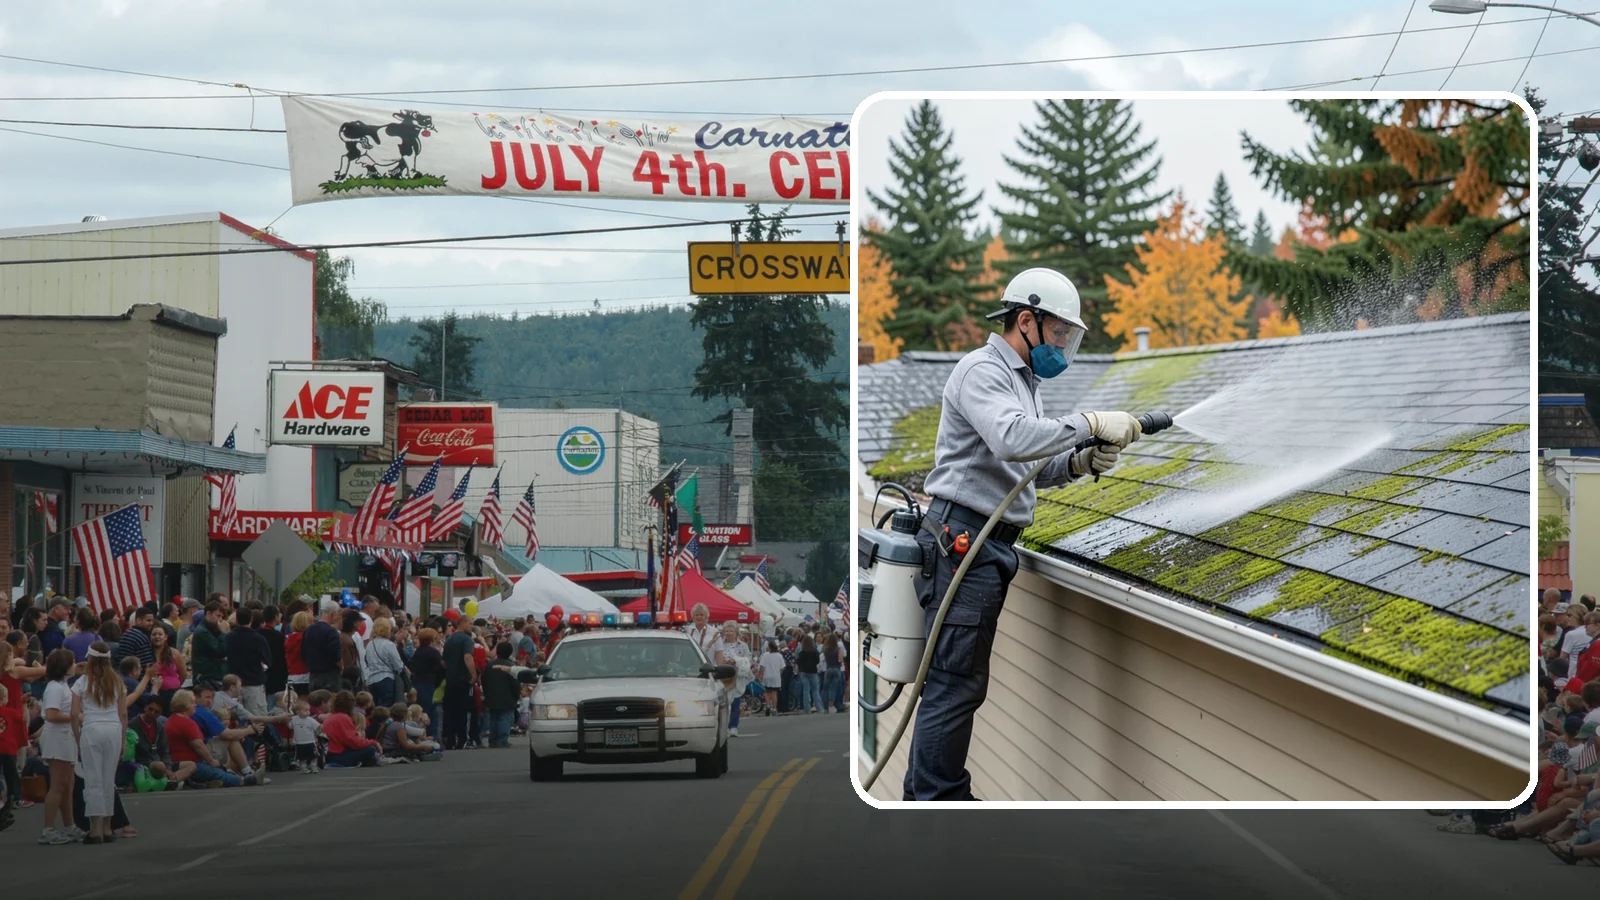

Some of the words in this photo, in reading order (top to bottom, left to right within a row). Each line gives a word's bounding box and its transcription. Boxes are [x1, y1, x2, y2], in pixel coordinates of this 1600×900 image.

[694, 121, 850, 150] Carnat
[481, 141, 605, 193] JULY
[632, 150, 747, 198] 4th.
[696, 254, 850, 280] CROSSWA
[282, 379, 374, 420] ACE
[405, 409, 452, 422] CEDAR
[461, 409, 485, 422] LOG
[283, 421, 371, 437] Hardware
[416, 427, 477, 447] Coca-Cola
[83, 485, 93, 494] St.
[96, 485, 125, 495] Vincent
[126, 486, 135, 495] de
[137, 486, 155, 495] Paul
[81, 503, 154, 522] THRT
[212, 515, 331, 536] HARDARE
[688, 526, 742, 535] CRNATION
[699, 535, 730, 543] GLASS
